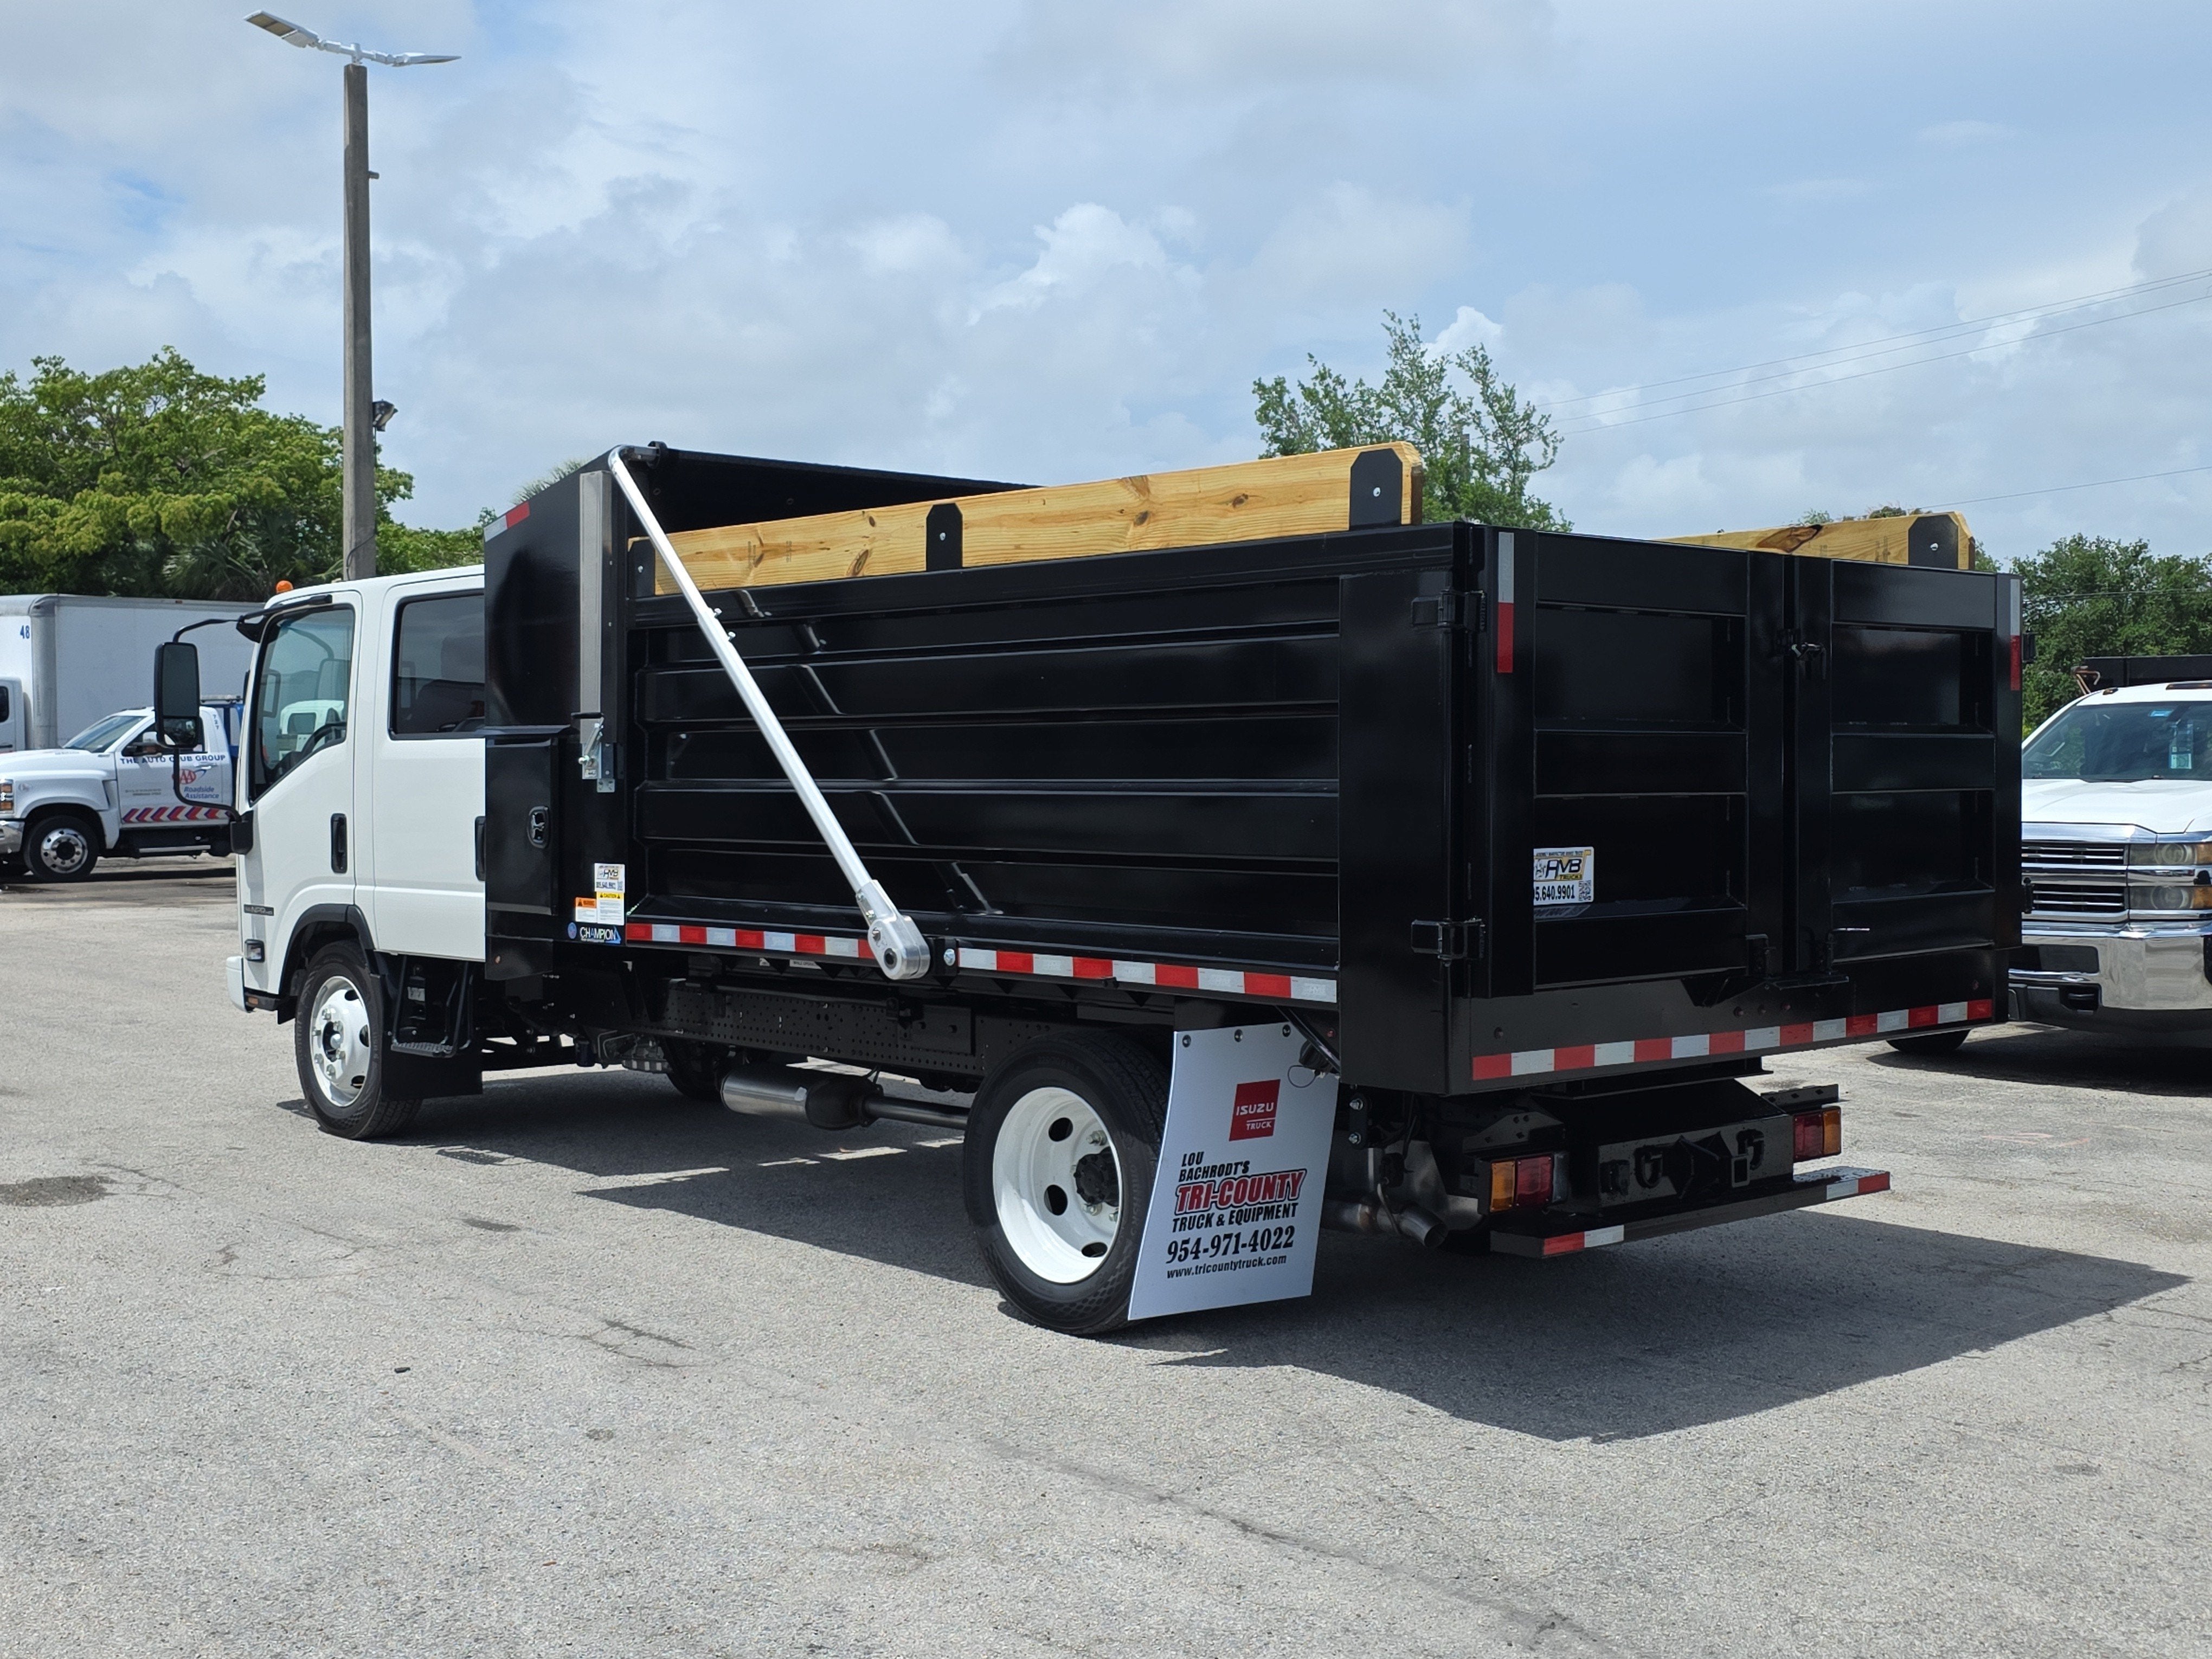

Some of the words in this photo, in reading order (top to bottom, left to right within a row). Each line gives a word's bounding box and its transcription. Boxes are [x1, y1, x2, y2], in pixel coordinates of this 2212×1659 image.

[20, 625, 30, 639] 48
[169, 754, 192, 763] CUB
[1534, 884, 1575, 901] 5.640.9901
[580, 927, 616, 941] CHAMPION
[1236, 1102, 1274, 1116] ISUZU
[1246, 1121, 1272, 1130] TRUCK
[1181, 1151, 1204, 1167] LOU
[1179, 1160, 1250, 1182] BACHRODT'S
[1175, 1169, 1307, 1215] TRI-COUNTY
[1172, 1212, 1215, 1233] TRUCK
[1216, 1214, 1225, 1226] &
[1228, 1203, 1299, 1226] EQUIPMENT
[1166, 1225, 1295, 1264] 954-971-4022
[1167, 1255, 1287, 1279] www.tricountytruck.com
